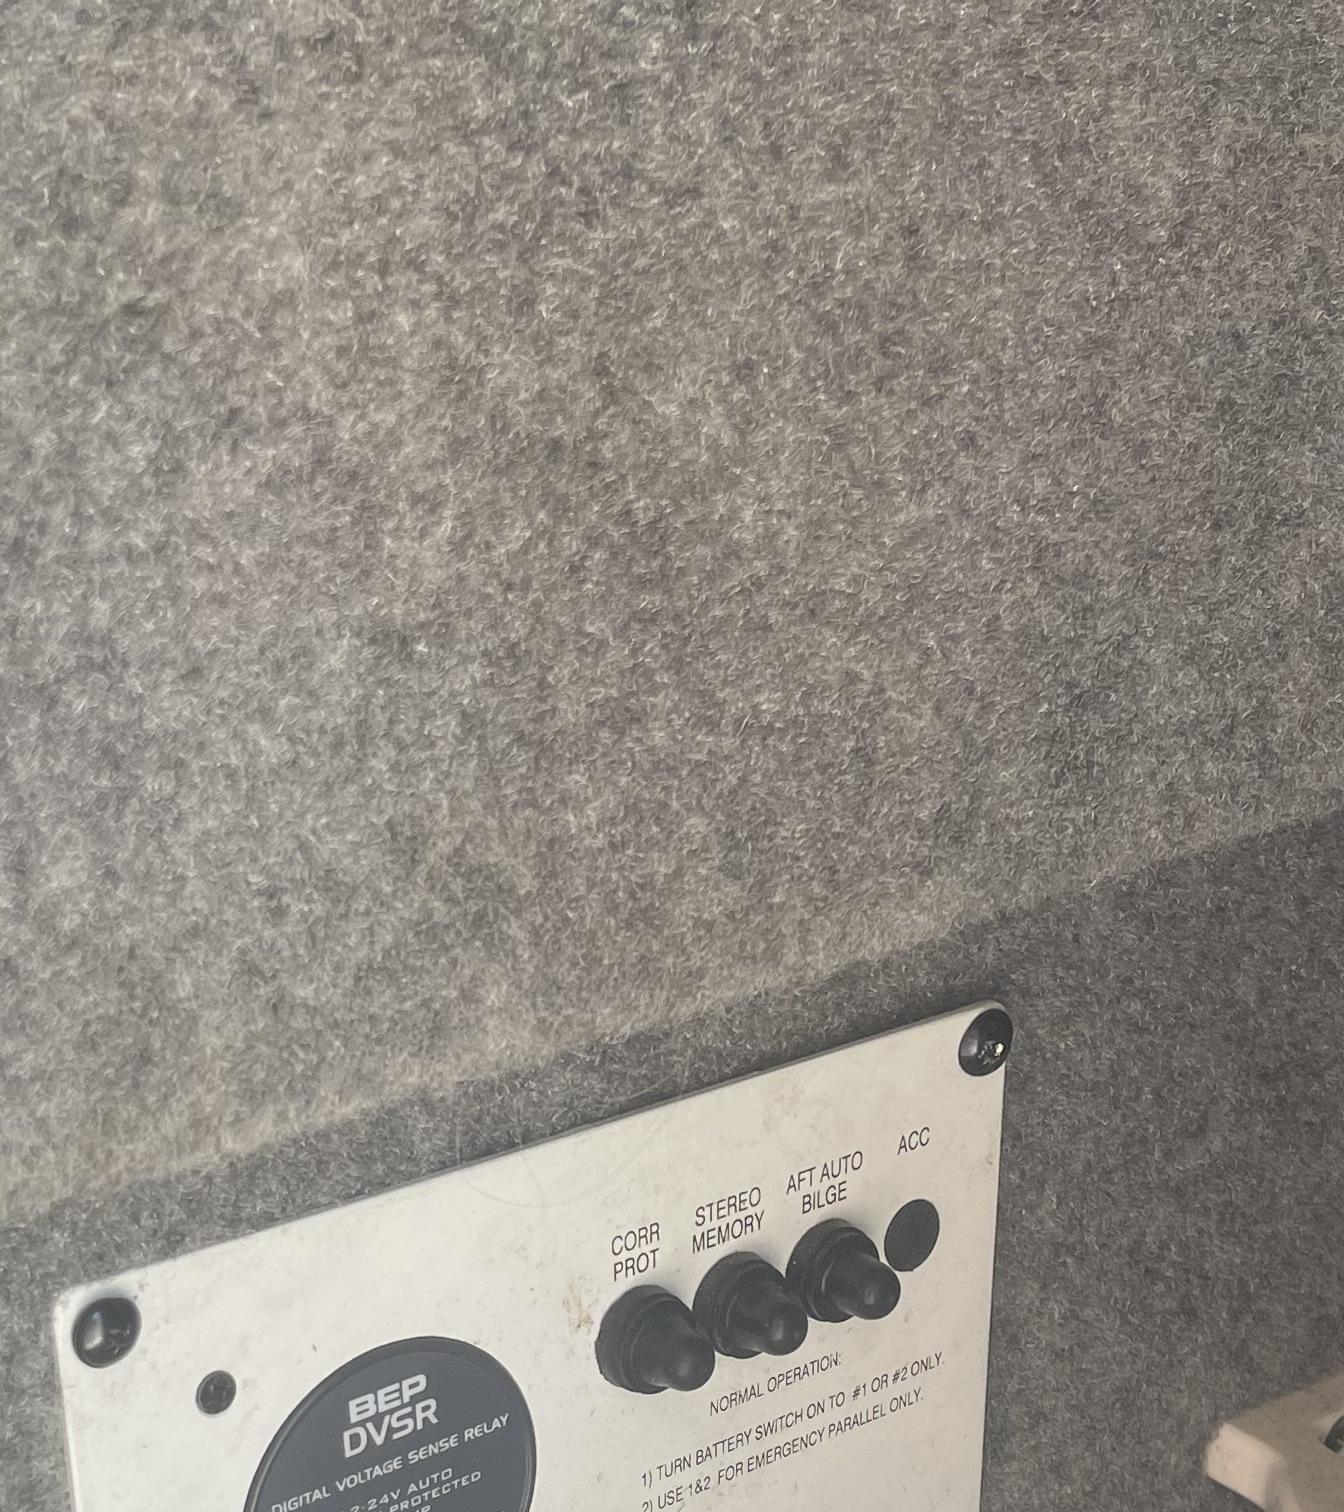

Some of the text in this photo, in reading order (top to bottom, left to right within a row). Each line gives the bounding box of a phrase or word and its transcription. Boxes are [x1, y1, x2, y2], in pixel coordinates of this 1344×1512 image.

[897, 1127, 930, 1156] ACC
[786, 1151, 863, 1194] AFT AUTO
[695, 1186, 762, 1227] STEREO
[801, 1181, 848, 1214] BILGE
[611, 1222, 660, 1256] CORR
[692, 1210, 766, 1254] MEMORY
[613, 1248, 659, 1282] PROT
[348, 1373, 427, 1424] BEP
[641, 1351, 945, 1487] 1) TURN BATTERY SWITCH ON TO #1 OR #2 ONLY.
[709, 1382, 764, 1416] NORMAL
[342, 1398, 439, 1458] DVSR
[657, 1485, 683, 1510] USE
[687, 1476, 711, 1496] 1&2
[717, 1462, 744, 1485] FOR
[747, 1426, 825, 1474] EMERGENCY
[828, 1404, 886, 1438] PARALLEL
[889, 1387, 924, 1412] ONLY.
[335, 1456, 403, 1492] VOLTAGE
[408, 1433, 459, 1464] SENSE
[463, 1413, 510, 1442] RELAY
[407, 1467, 453, 1493] AUTO
